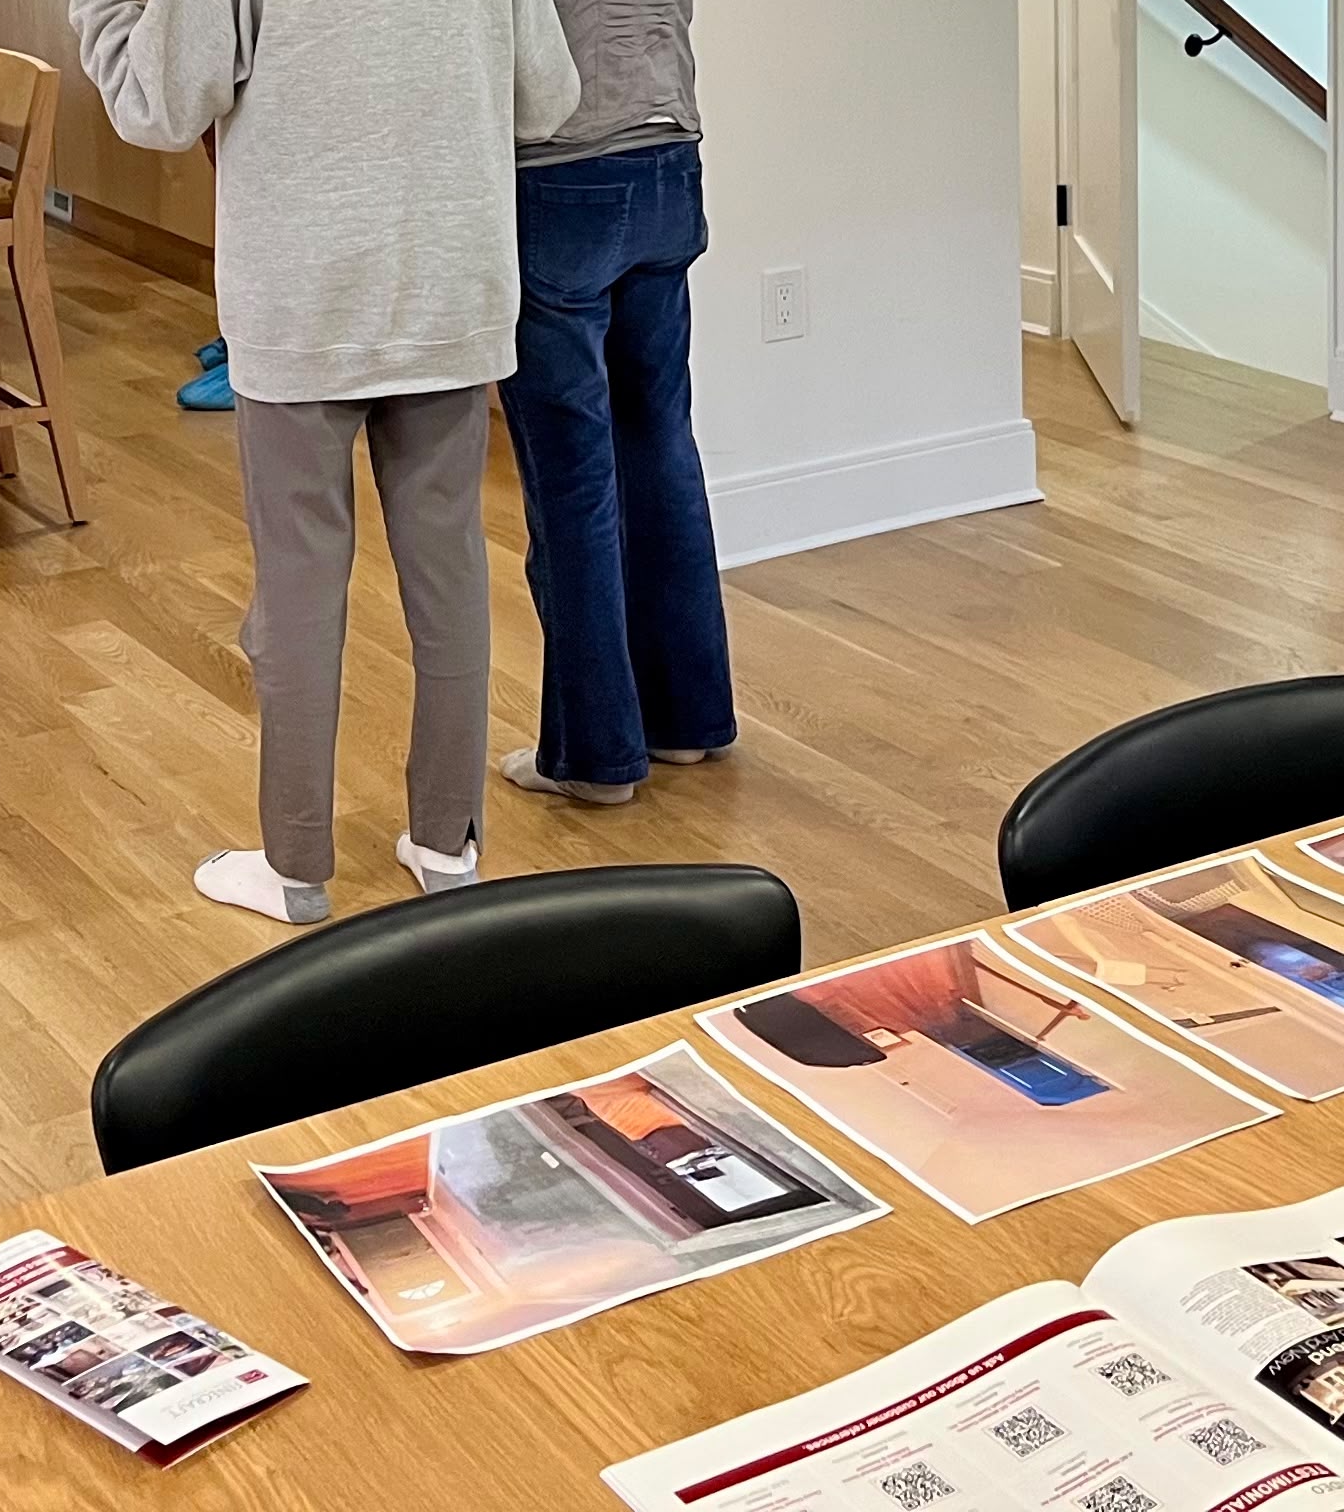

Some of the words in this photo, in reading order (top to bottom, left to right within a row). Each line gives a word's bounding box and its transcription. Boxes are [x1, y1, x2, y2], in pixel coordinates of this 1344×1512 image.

[1306, 1332, 1340, 1354] And
[966, 1364, 984, 1375] us
[982, 1352, 1004, 1369] Ask
[1267, 1345, 1306, 1376] New
[935, 1373, 969, 1393] about
[918, 1389, 937, 1402] our
[866, 1400, 917, 1427] customer
